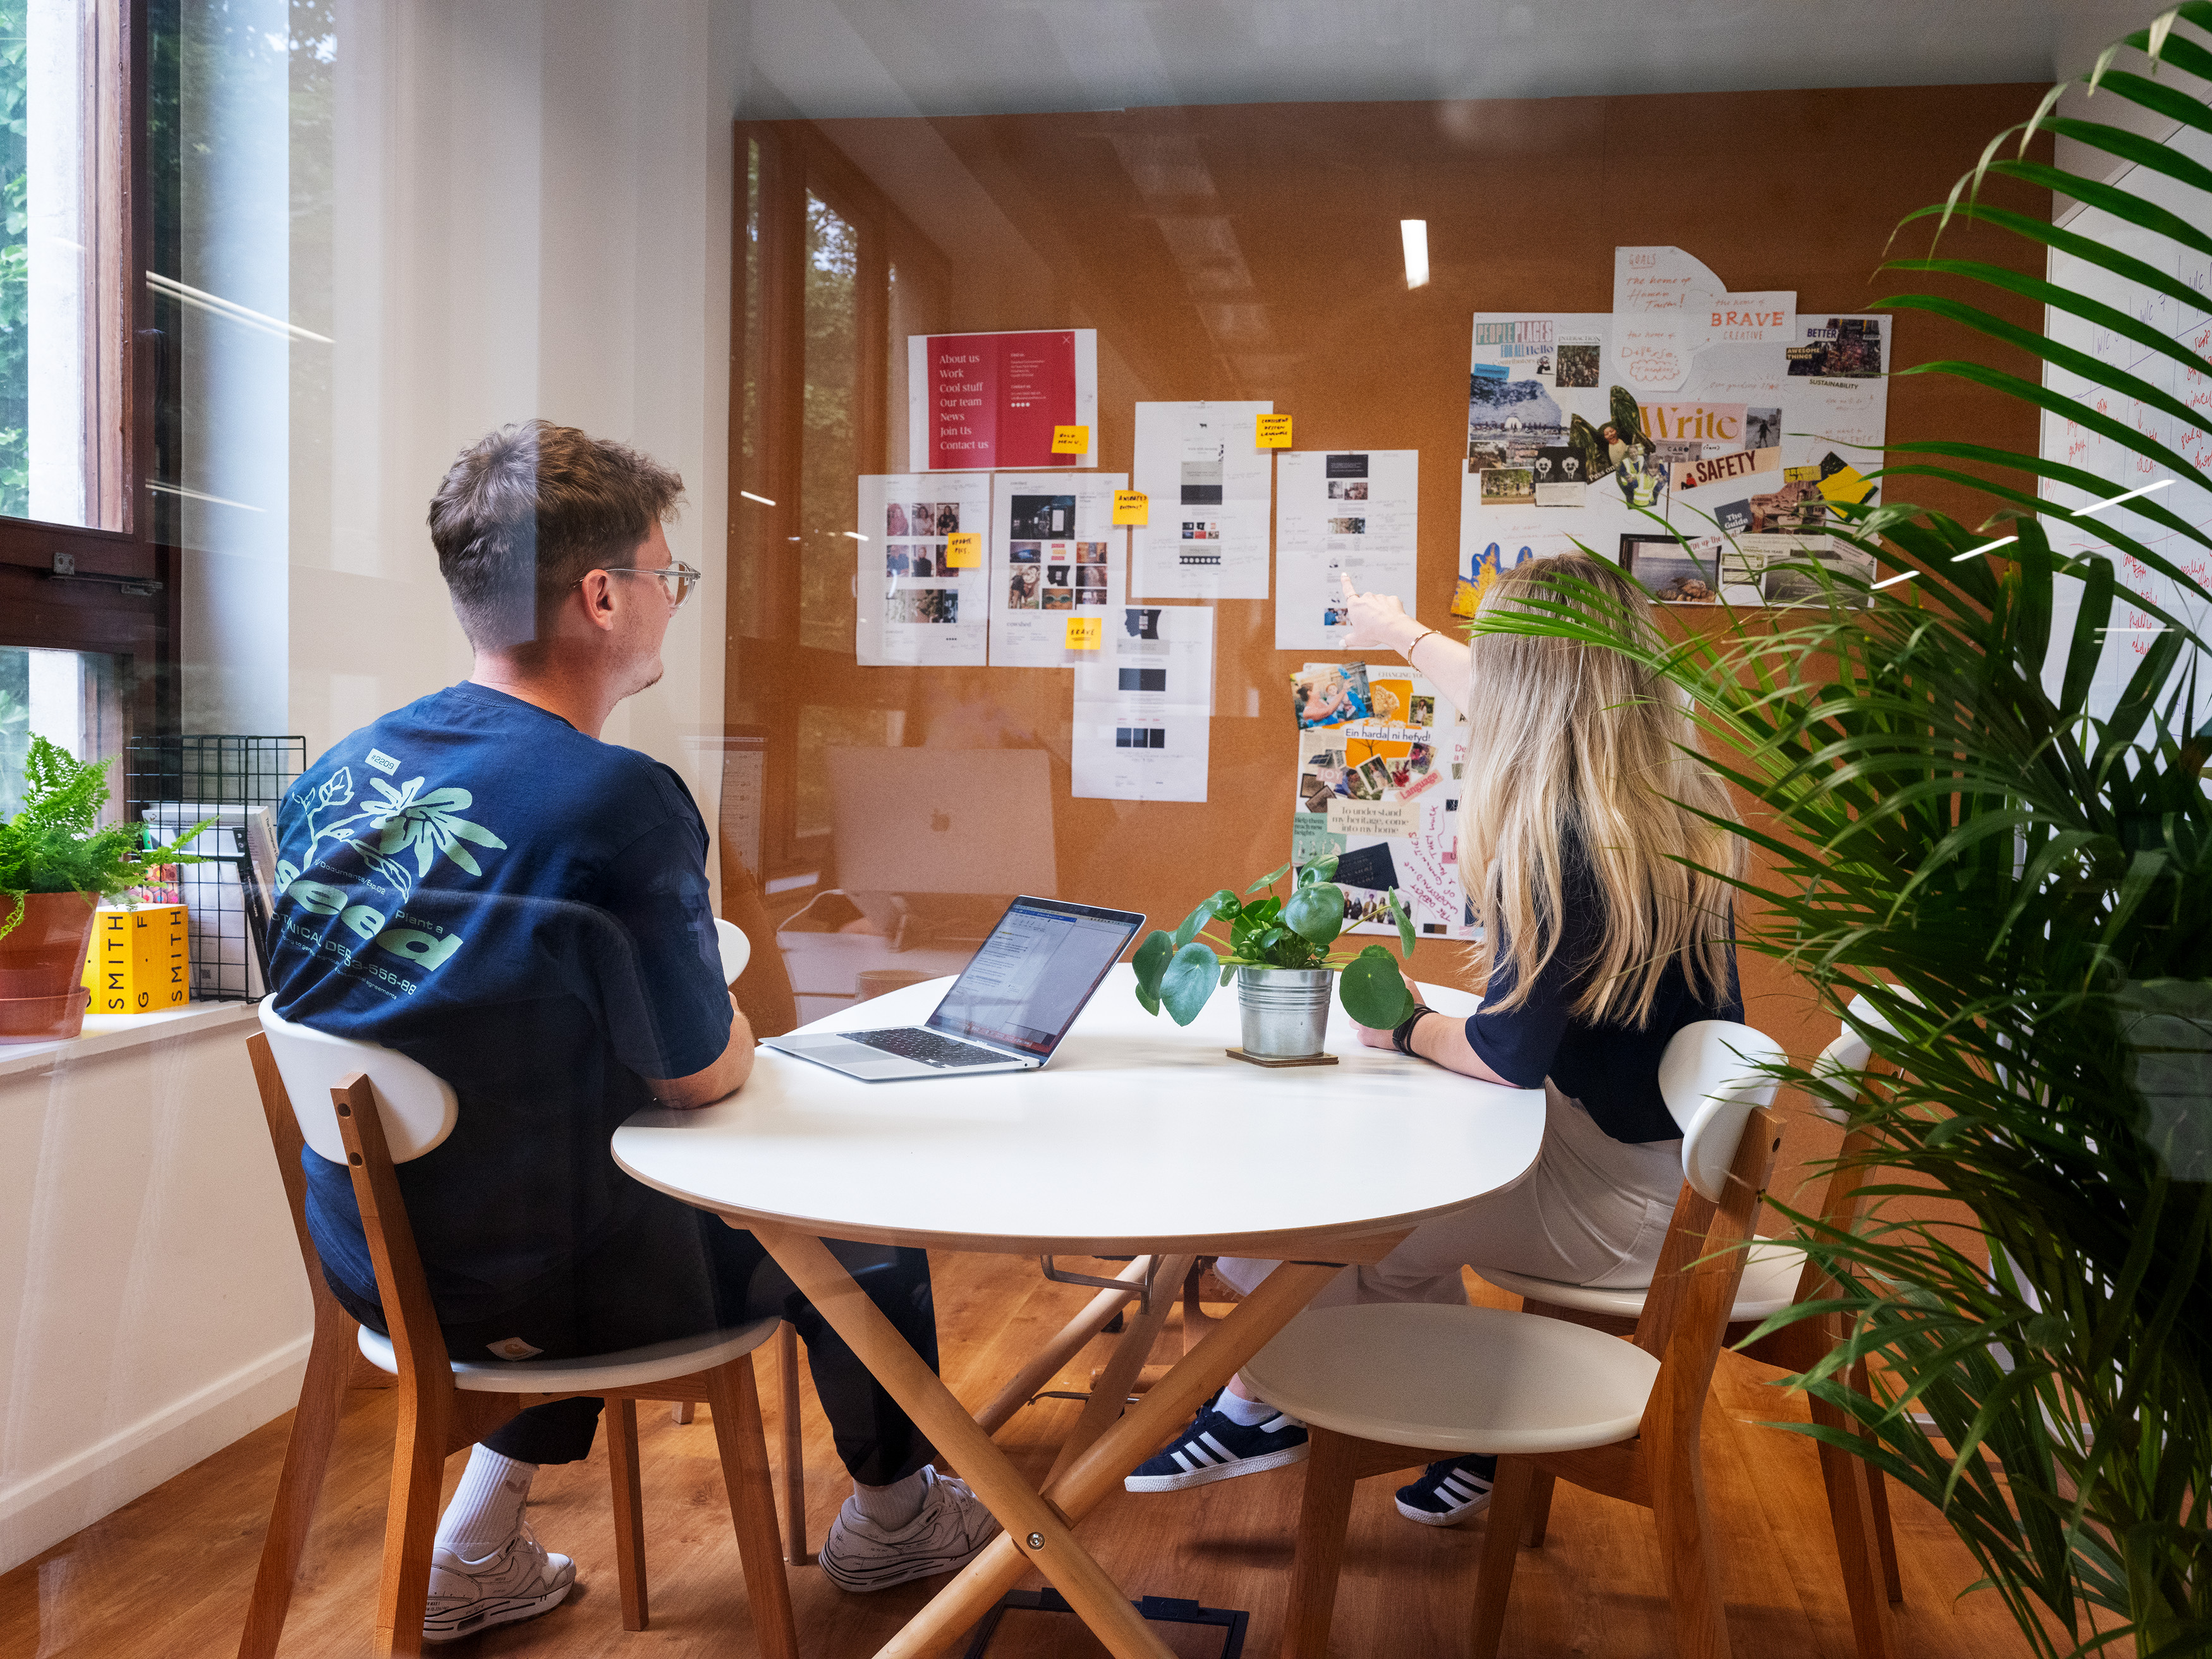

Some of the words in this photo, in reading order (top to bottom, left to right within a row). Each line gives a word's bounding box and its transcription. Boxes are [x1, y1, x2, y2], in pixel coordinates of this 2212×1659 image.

[1711, 311, 1784, 327] BRAVE
[1477, 323, 1513, 344] PEOPLE
[1516, 320, 1553, 343] PLACES
[1723, 331, 1763, 340] CREATIVE
[1807, 329, 1837, 338] BETTER
[1526, 344, 1553, 355] Hello
[939, 354, 967, 364] About
[969, 355, 980, 363] us
[940, 369, 964, 379] Work
[939, 384, 961, 393] Cool
[963, 382, 983, 392] stuff
[1809, 379, 1859, 390] SUSTAINABILITY
[940, 398, 957, 407] Our
[959, 398, 982, 407] team
[940, 413, 965, 422] News
[1639, 406, 1738, 440] Write
[940, 427, 957, 437] Join
[940, 441, 976, 450] Contact
[1696, 450, 1756, 483] SAFETY
[1726, 512, 1742, 522] The
[1725, 517, 1749, 530] Guide
[1071, 628, 1095, 636] BRAVE
[1346, 729, 1359, 738] Ein
[1392, 731, 1401, 739] ni
[1402, 729, 1431, 743] hefyd!
[371, 755, 395, 770] #2209
[1320, 769, 1342, 779] JOY
[1399, 772, 1438, 800] Language
[1353, 808, 1402, 817] understand
[1375, 825, 1399, 834] home
[395, 909, 433, 930] Plant
[435, 925, 444, 934] a
[170, 910, 183, 1002] SMITH
[107, 916, 125, 1010] SMITH
[366, 981, 398, 1000] agreements
